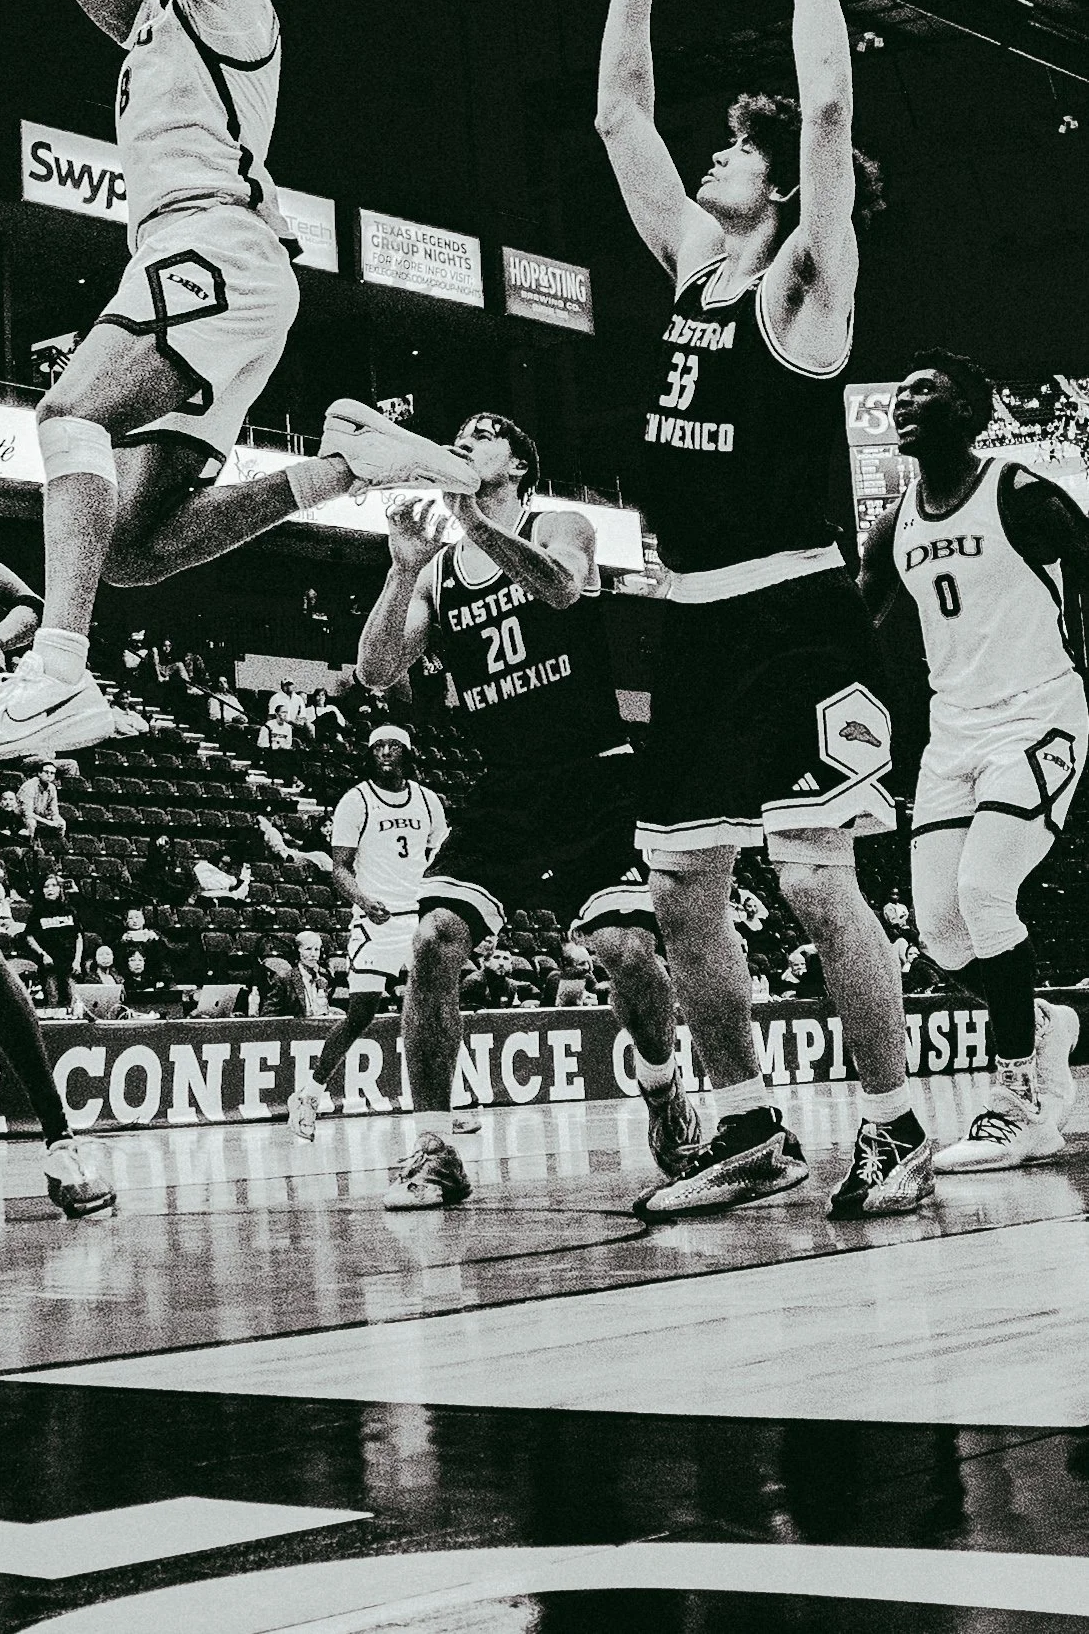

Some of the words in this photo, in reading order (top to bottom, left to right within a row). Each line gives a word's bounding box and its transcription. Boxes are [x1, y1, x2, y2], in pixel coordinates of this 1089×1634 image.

[286, 214, 333, 241] Tech
[373, 220, 412, 241] TEXAS
[414, 229, 468, 255] LEGENDS
[371, 234, 419, 257] GROUP
[422, 246, 472, 271] NIGHTS
[372, 252, 392, 265] FOR
[394, 256, 424, 274] MORE
[425, 262, 449, 280] INFO
[166, 273, 210, 301] DBU
[510, 256, 587, 303] HOP&STING
[658, 351, 699, 411] 33
[660, 415, 735, 452] MEXICO
[904, 534, 985, 573] DBU
[931, 571, 964, 621] 0
[480, 615, 527, 675] 20
[462, 681, 499, 712] NEW
[499, 654, 572, 700] MEXICO
[378, 818, 422, 833] DBU
[396, 835, 410, 859] 3
[52, 1028, 586, 1130] CONFERNCE
